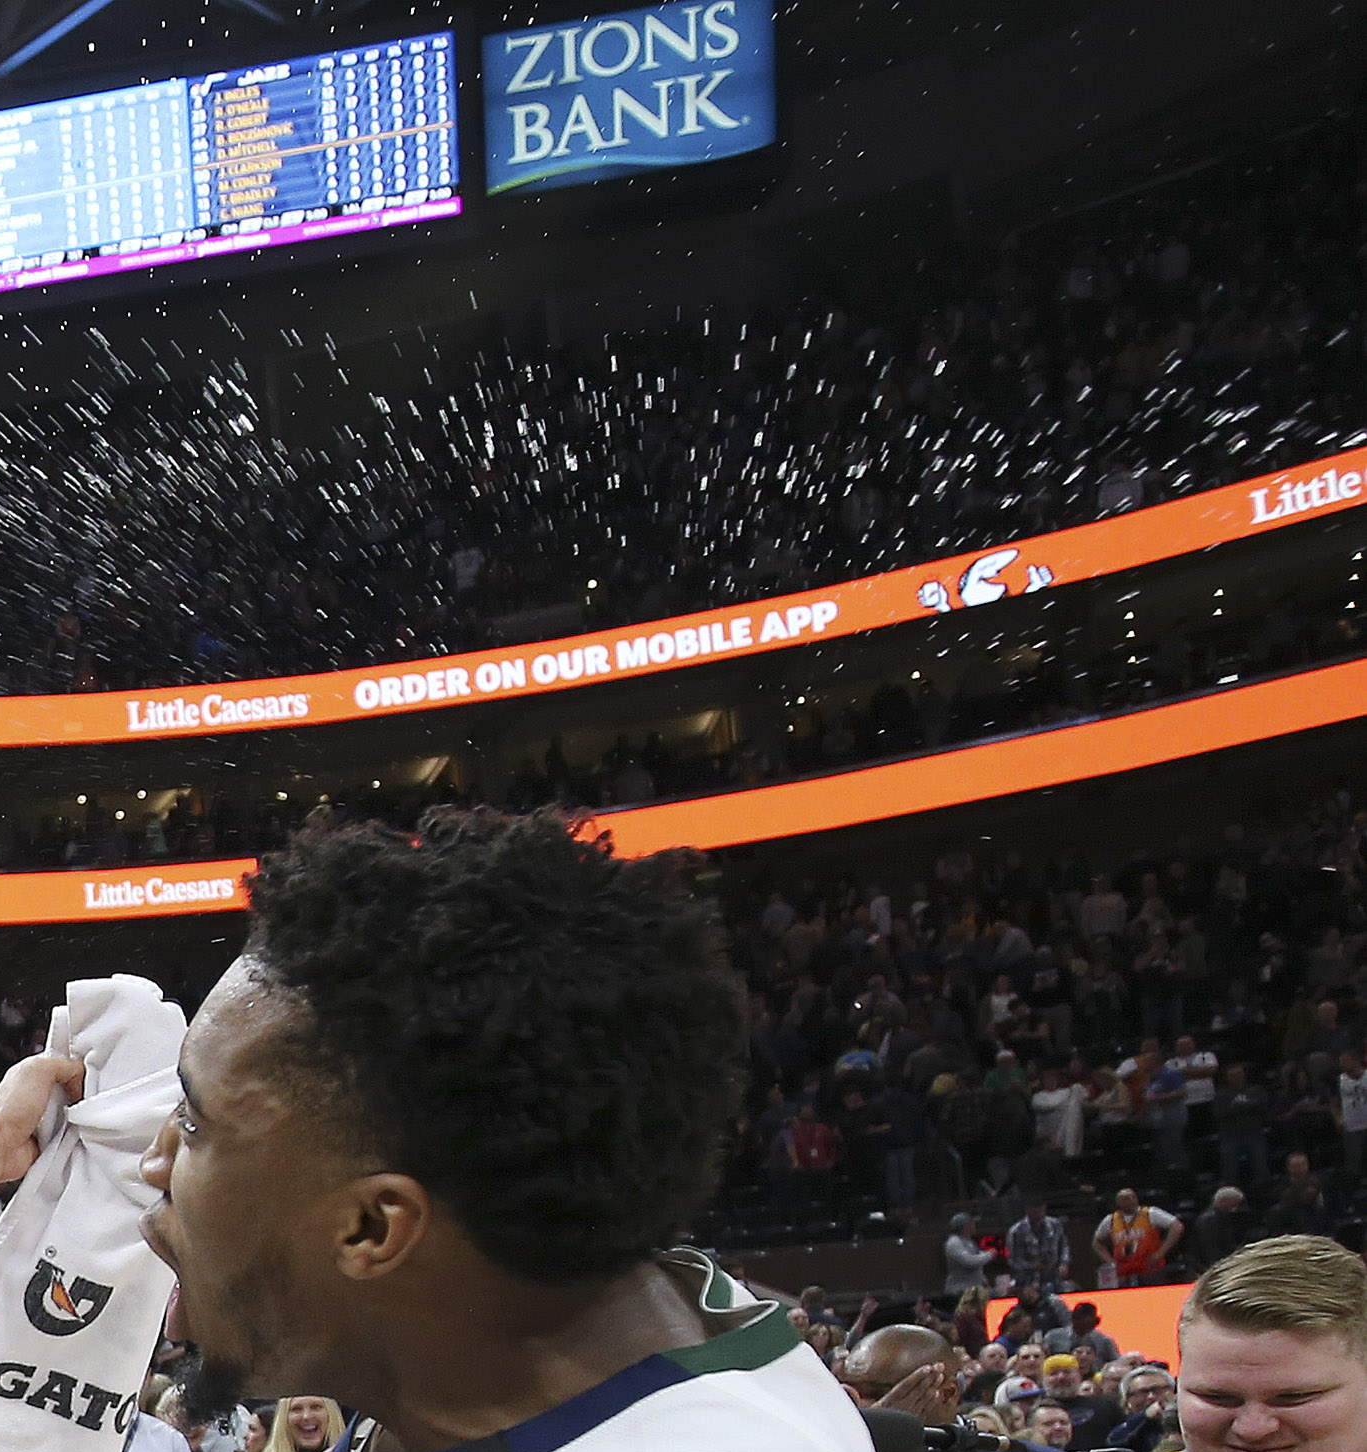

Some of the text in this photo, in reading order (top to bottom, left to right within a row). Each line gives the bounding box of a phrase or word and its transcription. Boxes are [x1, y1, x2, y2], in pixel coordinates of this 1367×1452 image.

[505, 0, 740, 95] ZIONS
[506, 68, 741, 165] BANK
[1248, 468, 1362, 525] Little
[354, 600, 838, 710] ORDER ON OUR MOBILE APP
[126, 692, 309, 731] Little Caesars
[84, 877, 234, 909] Little Caesars
